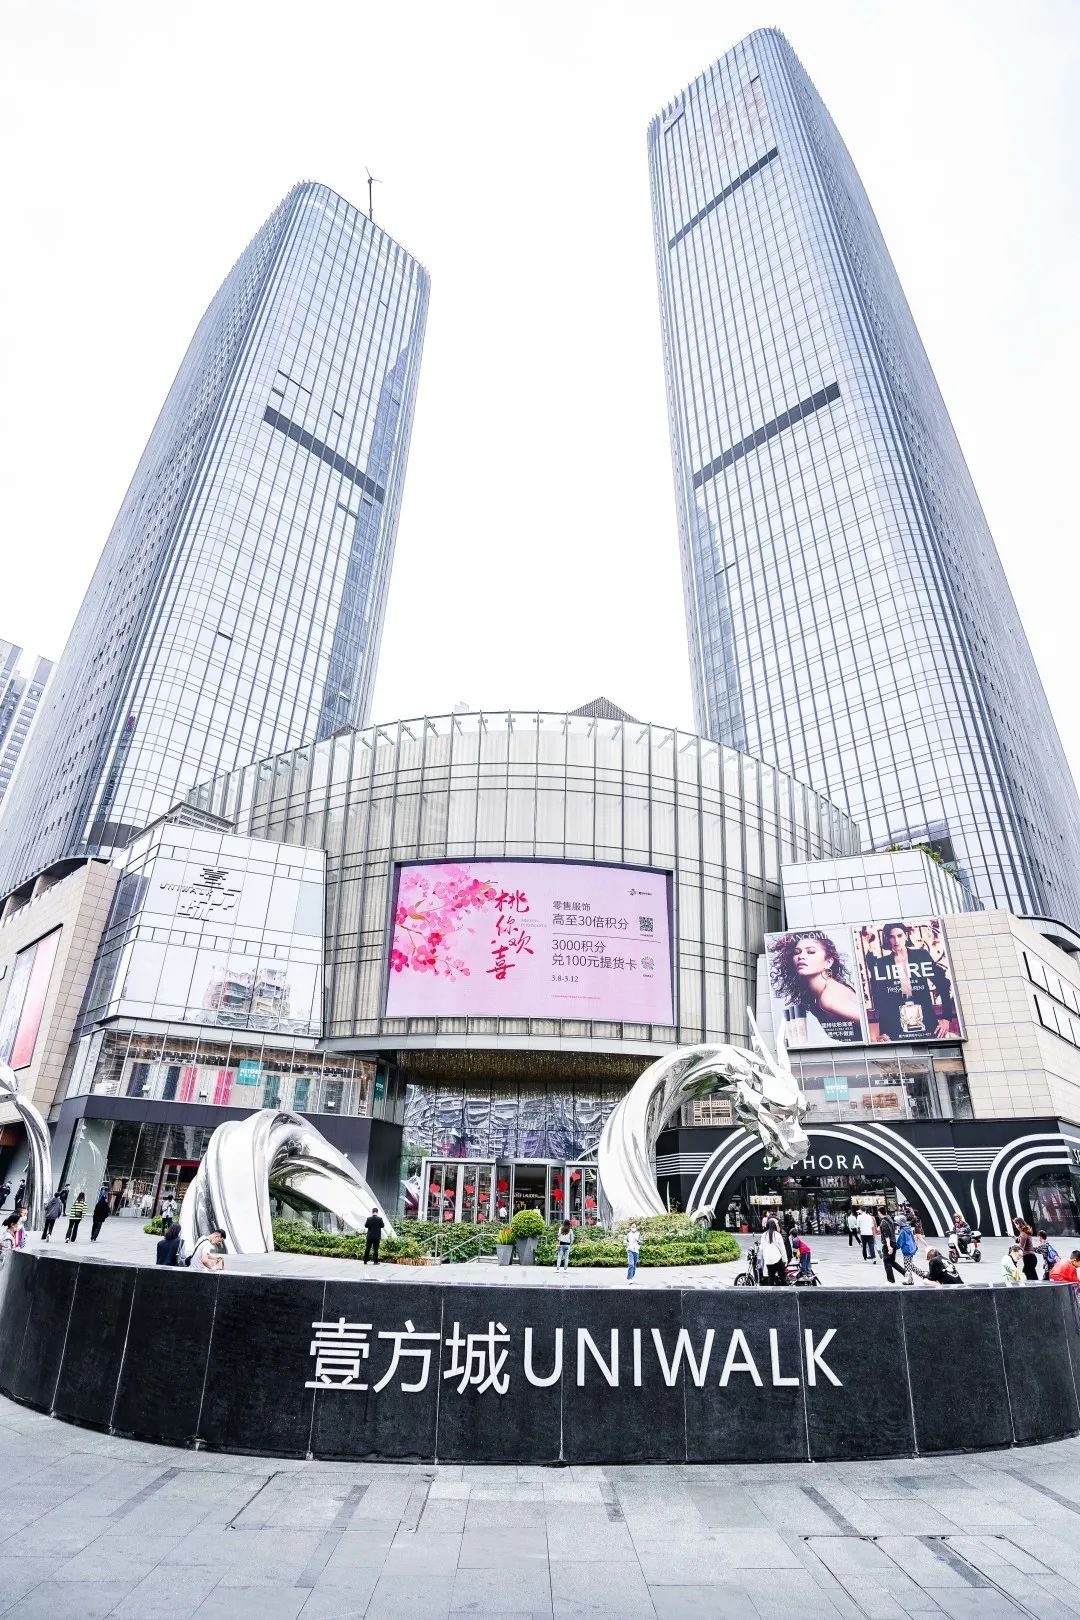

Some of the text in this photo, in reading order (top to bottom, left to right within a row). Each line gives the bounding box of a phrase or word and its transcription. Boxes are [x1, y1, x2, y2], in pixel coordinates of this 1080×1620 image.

[552, 900, 591, 912] 零售服饰
[552, 913, 630, 930] 高至30倍积分
[551, 939, 606, 953] 3000积分
[551, 953, 638, 971] 兑100元提货卡
[763, 1154, 865, 1170] SPHORA
[304, 1317, 843, 1395] 壹方城 UNIWALK
